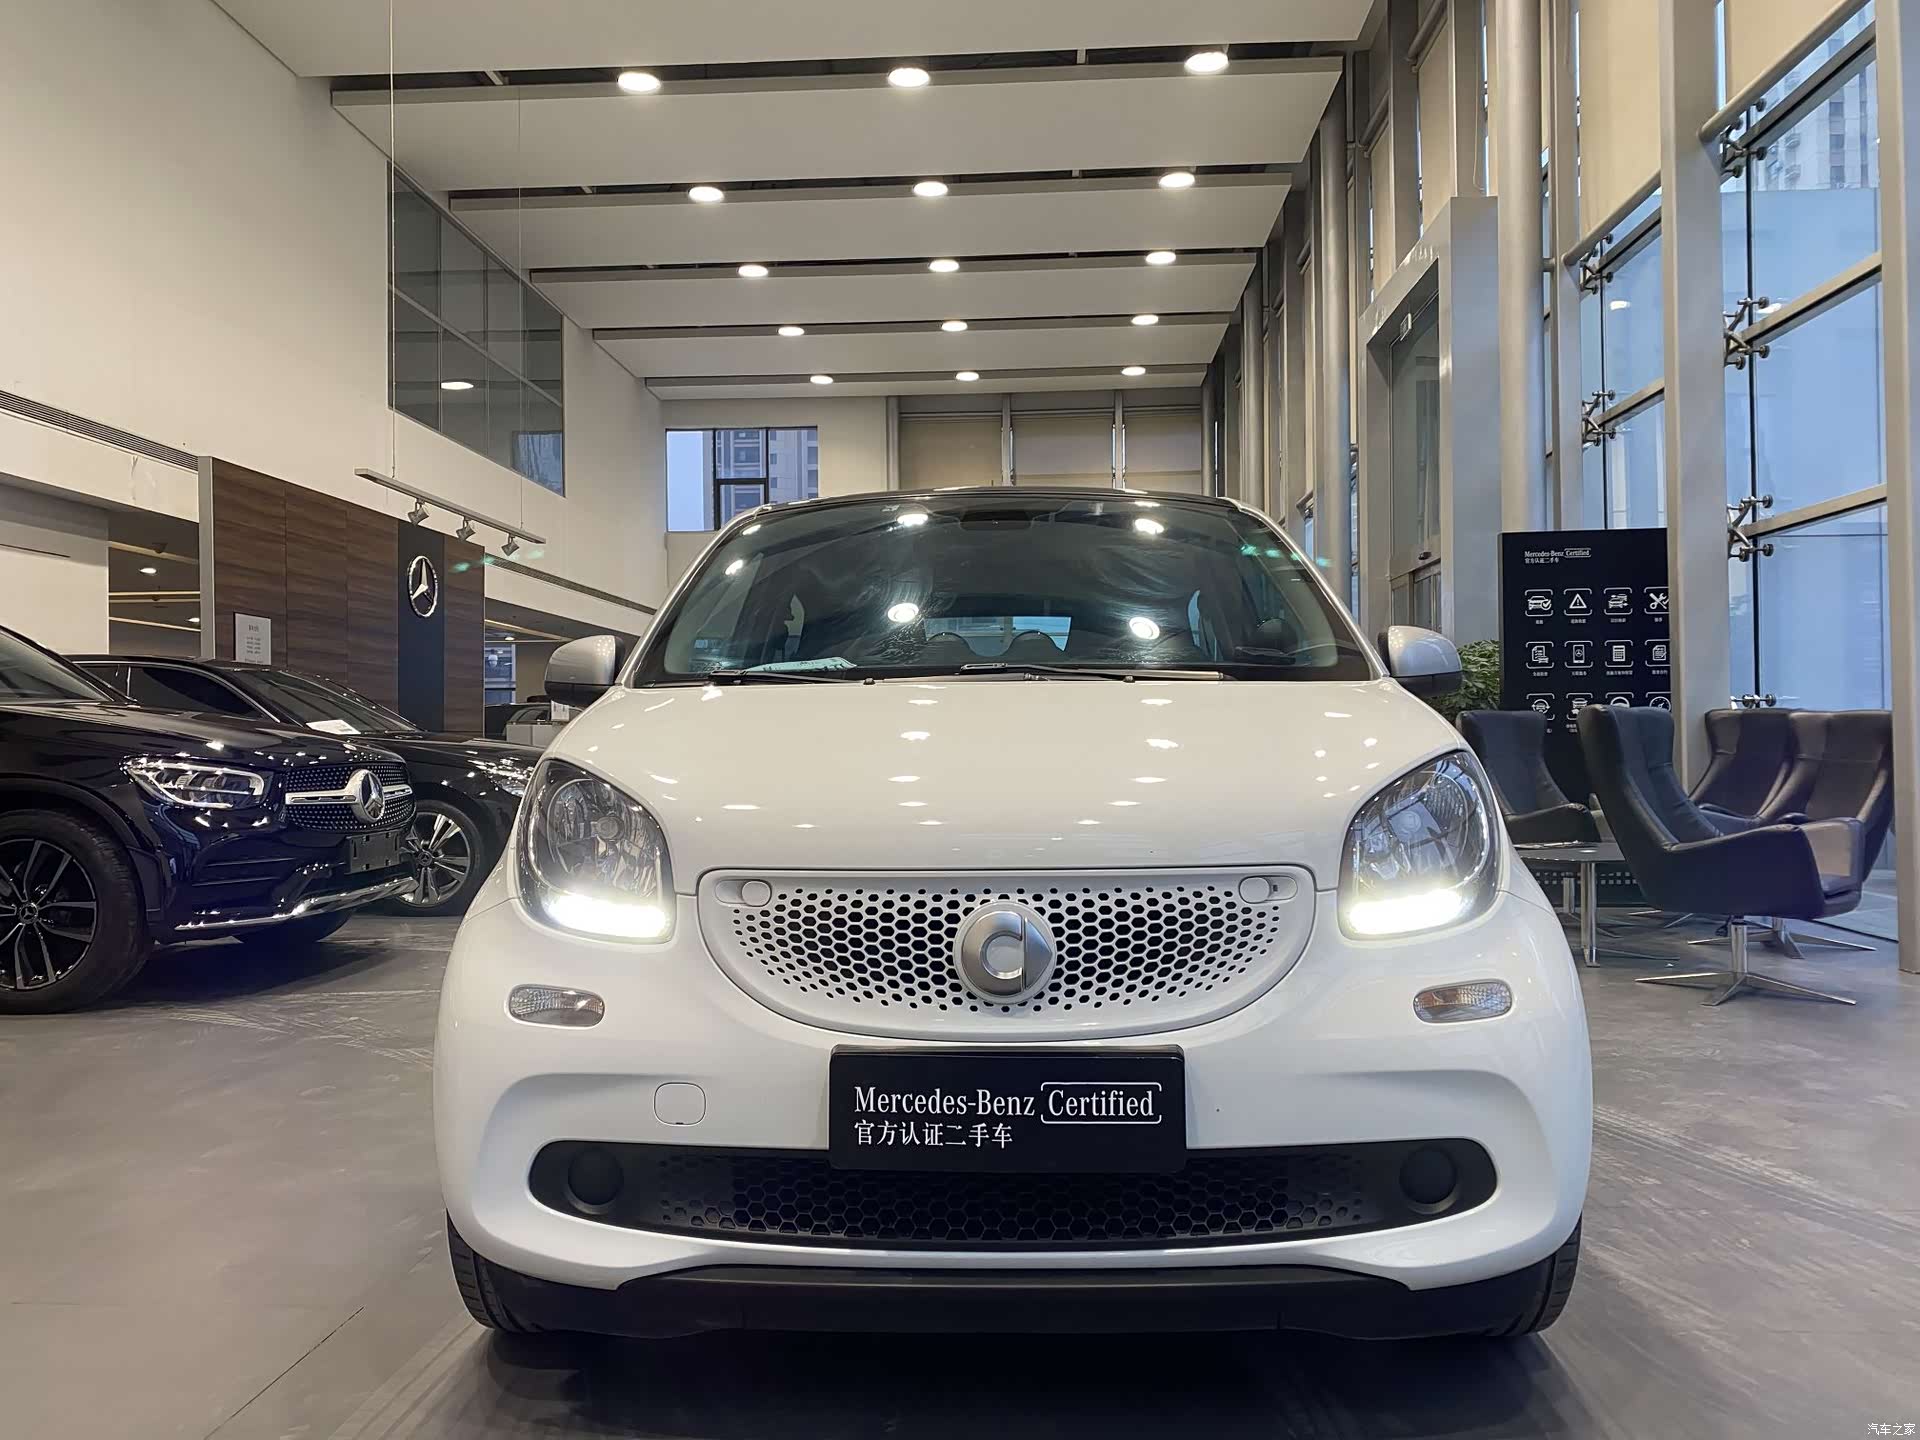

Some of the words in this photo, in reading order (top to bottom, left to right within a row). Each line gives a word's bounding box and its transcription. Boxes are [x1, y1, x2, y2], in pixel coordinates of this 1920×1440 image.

[854, 1086, 1035, 1117] Mercedes-Benz
[1048, 1089, 1154, 1117] Certified
[854, 1119, 1014, 1149] 官方认证二手车
